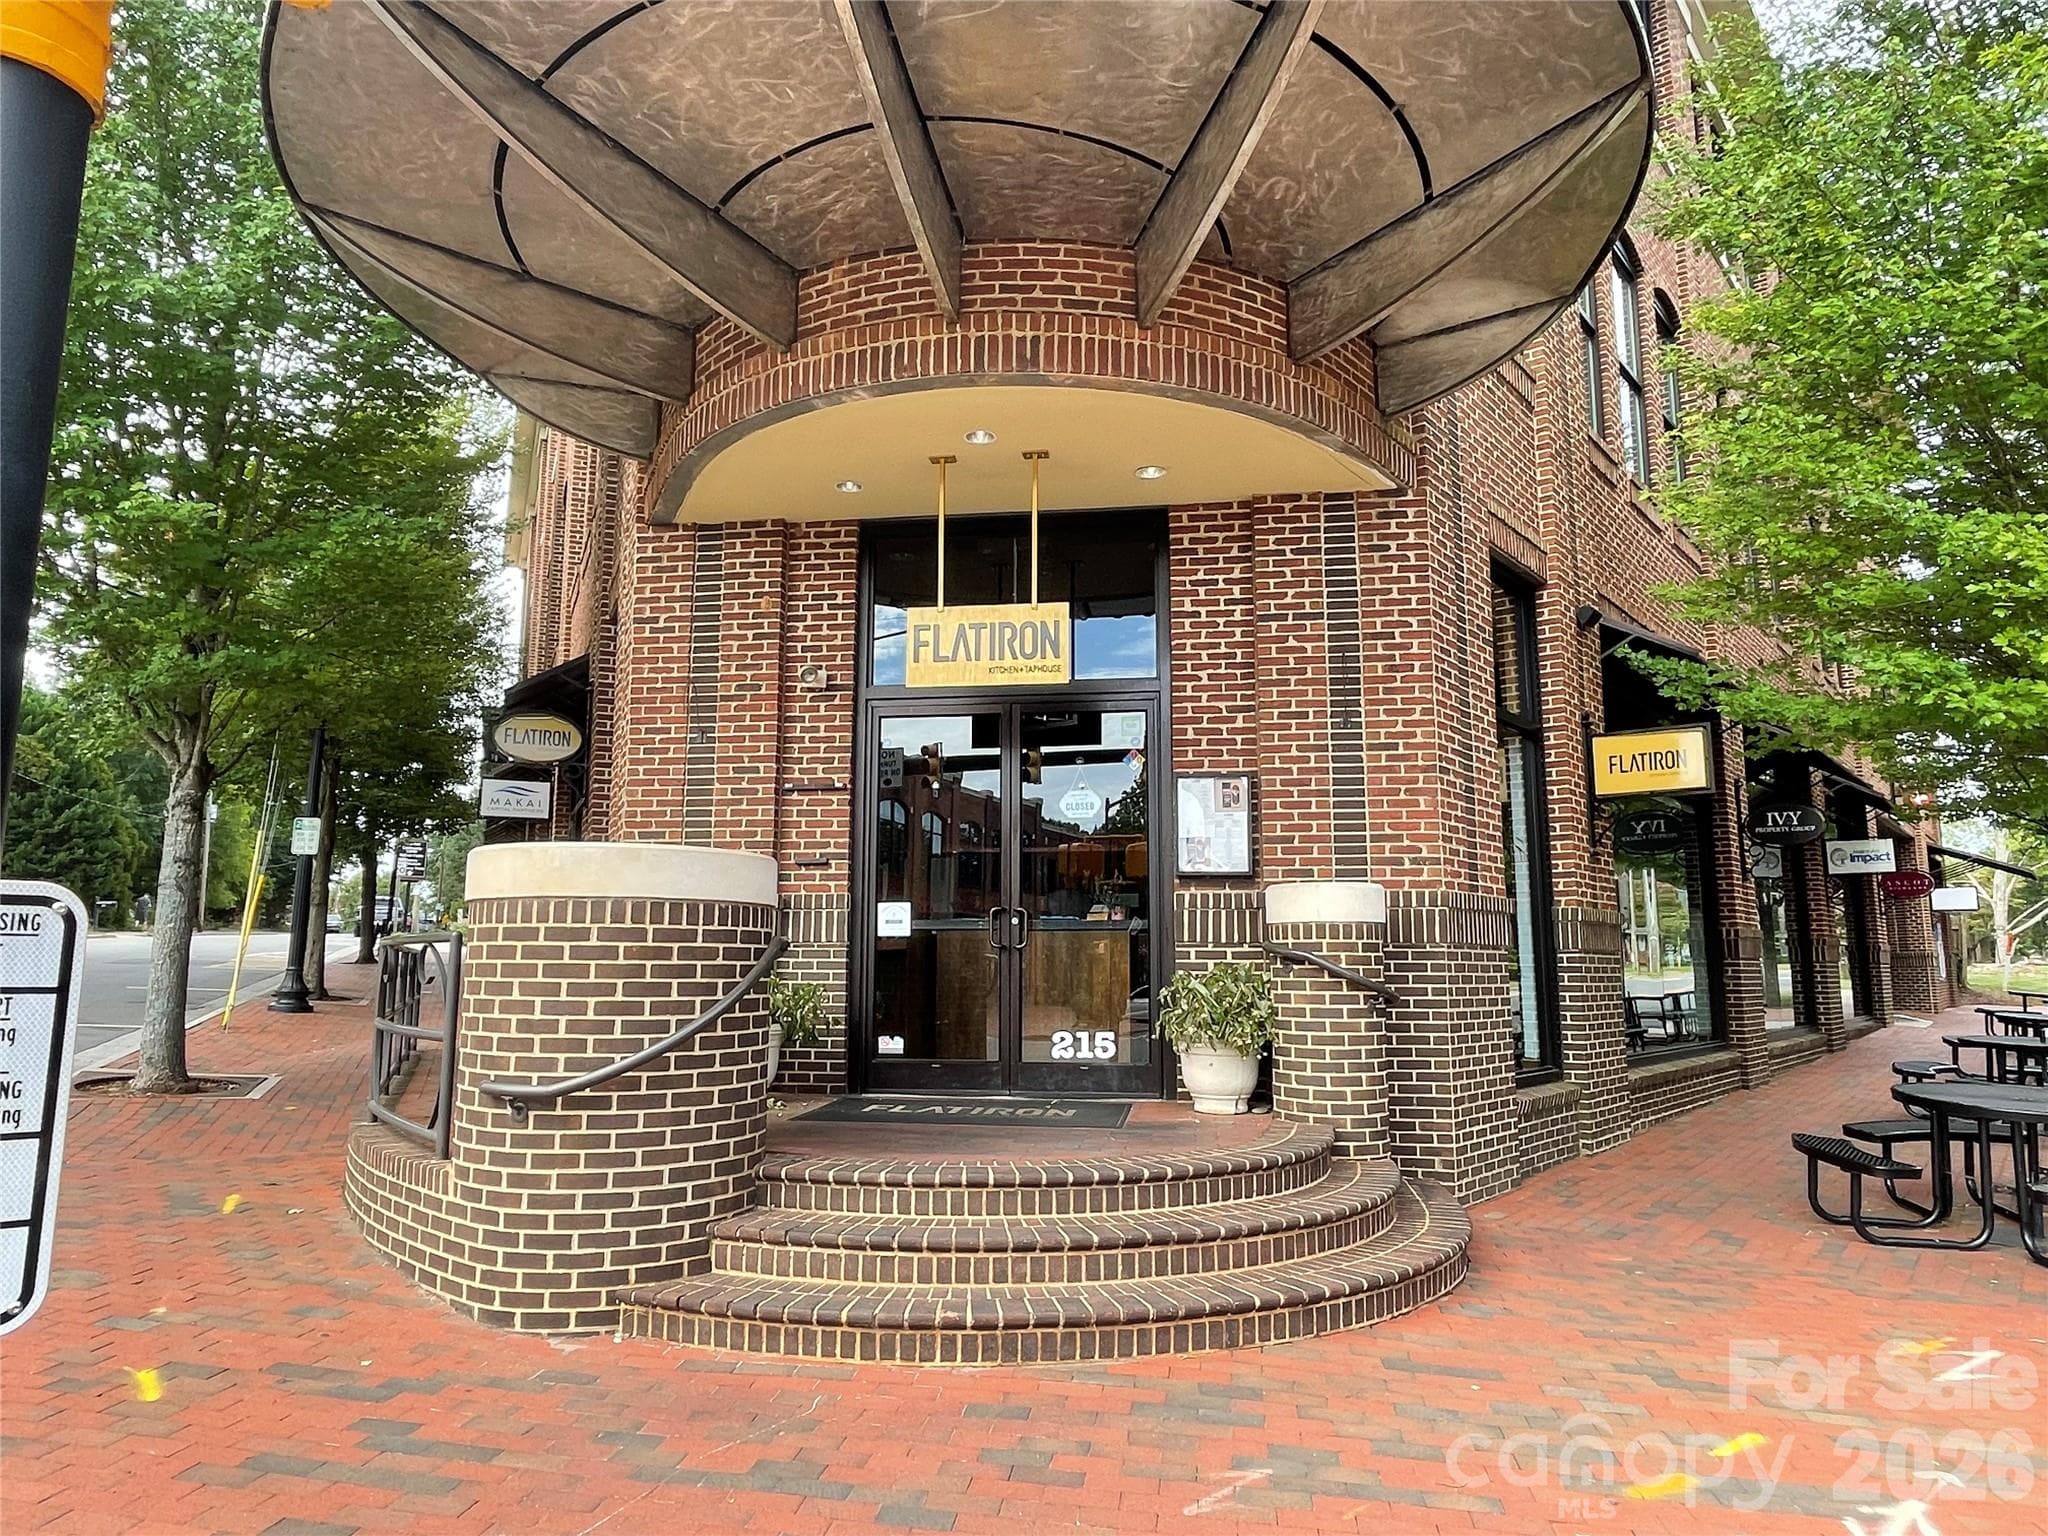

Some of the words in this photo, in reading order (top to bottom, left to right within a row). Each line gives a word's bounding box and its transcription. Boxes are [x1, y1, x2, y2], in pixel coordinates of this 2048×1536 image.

[913, 620, 1060, 663] FLATIRON
[504, 728, 571, 747] FLATIRON
[1609, 750, 1687, 774] FLATIRON
[490, 798, 541, 808] MAKAI
[1066, 802, 1095, 811] CLOSED
[1766, 811, 1802, 826] IVY
[1849, 851, 1891, 864] Impact
[1051, 1030, 1117, 1059] 215
[861, 1104, 1077, 1116] FLATIRON
